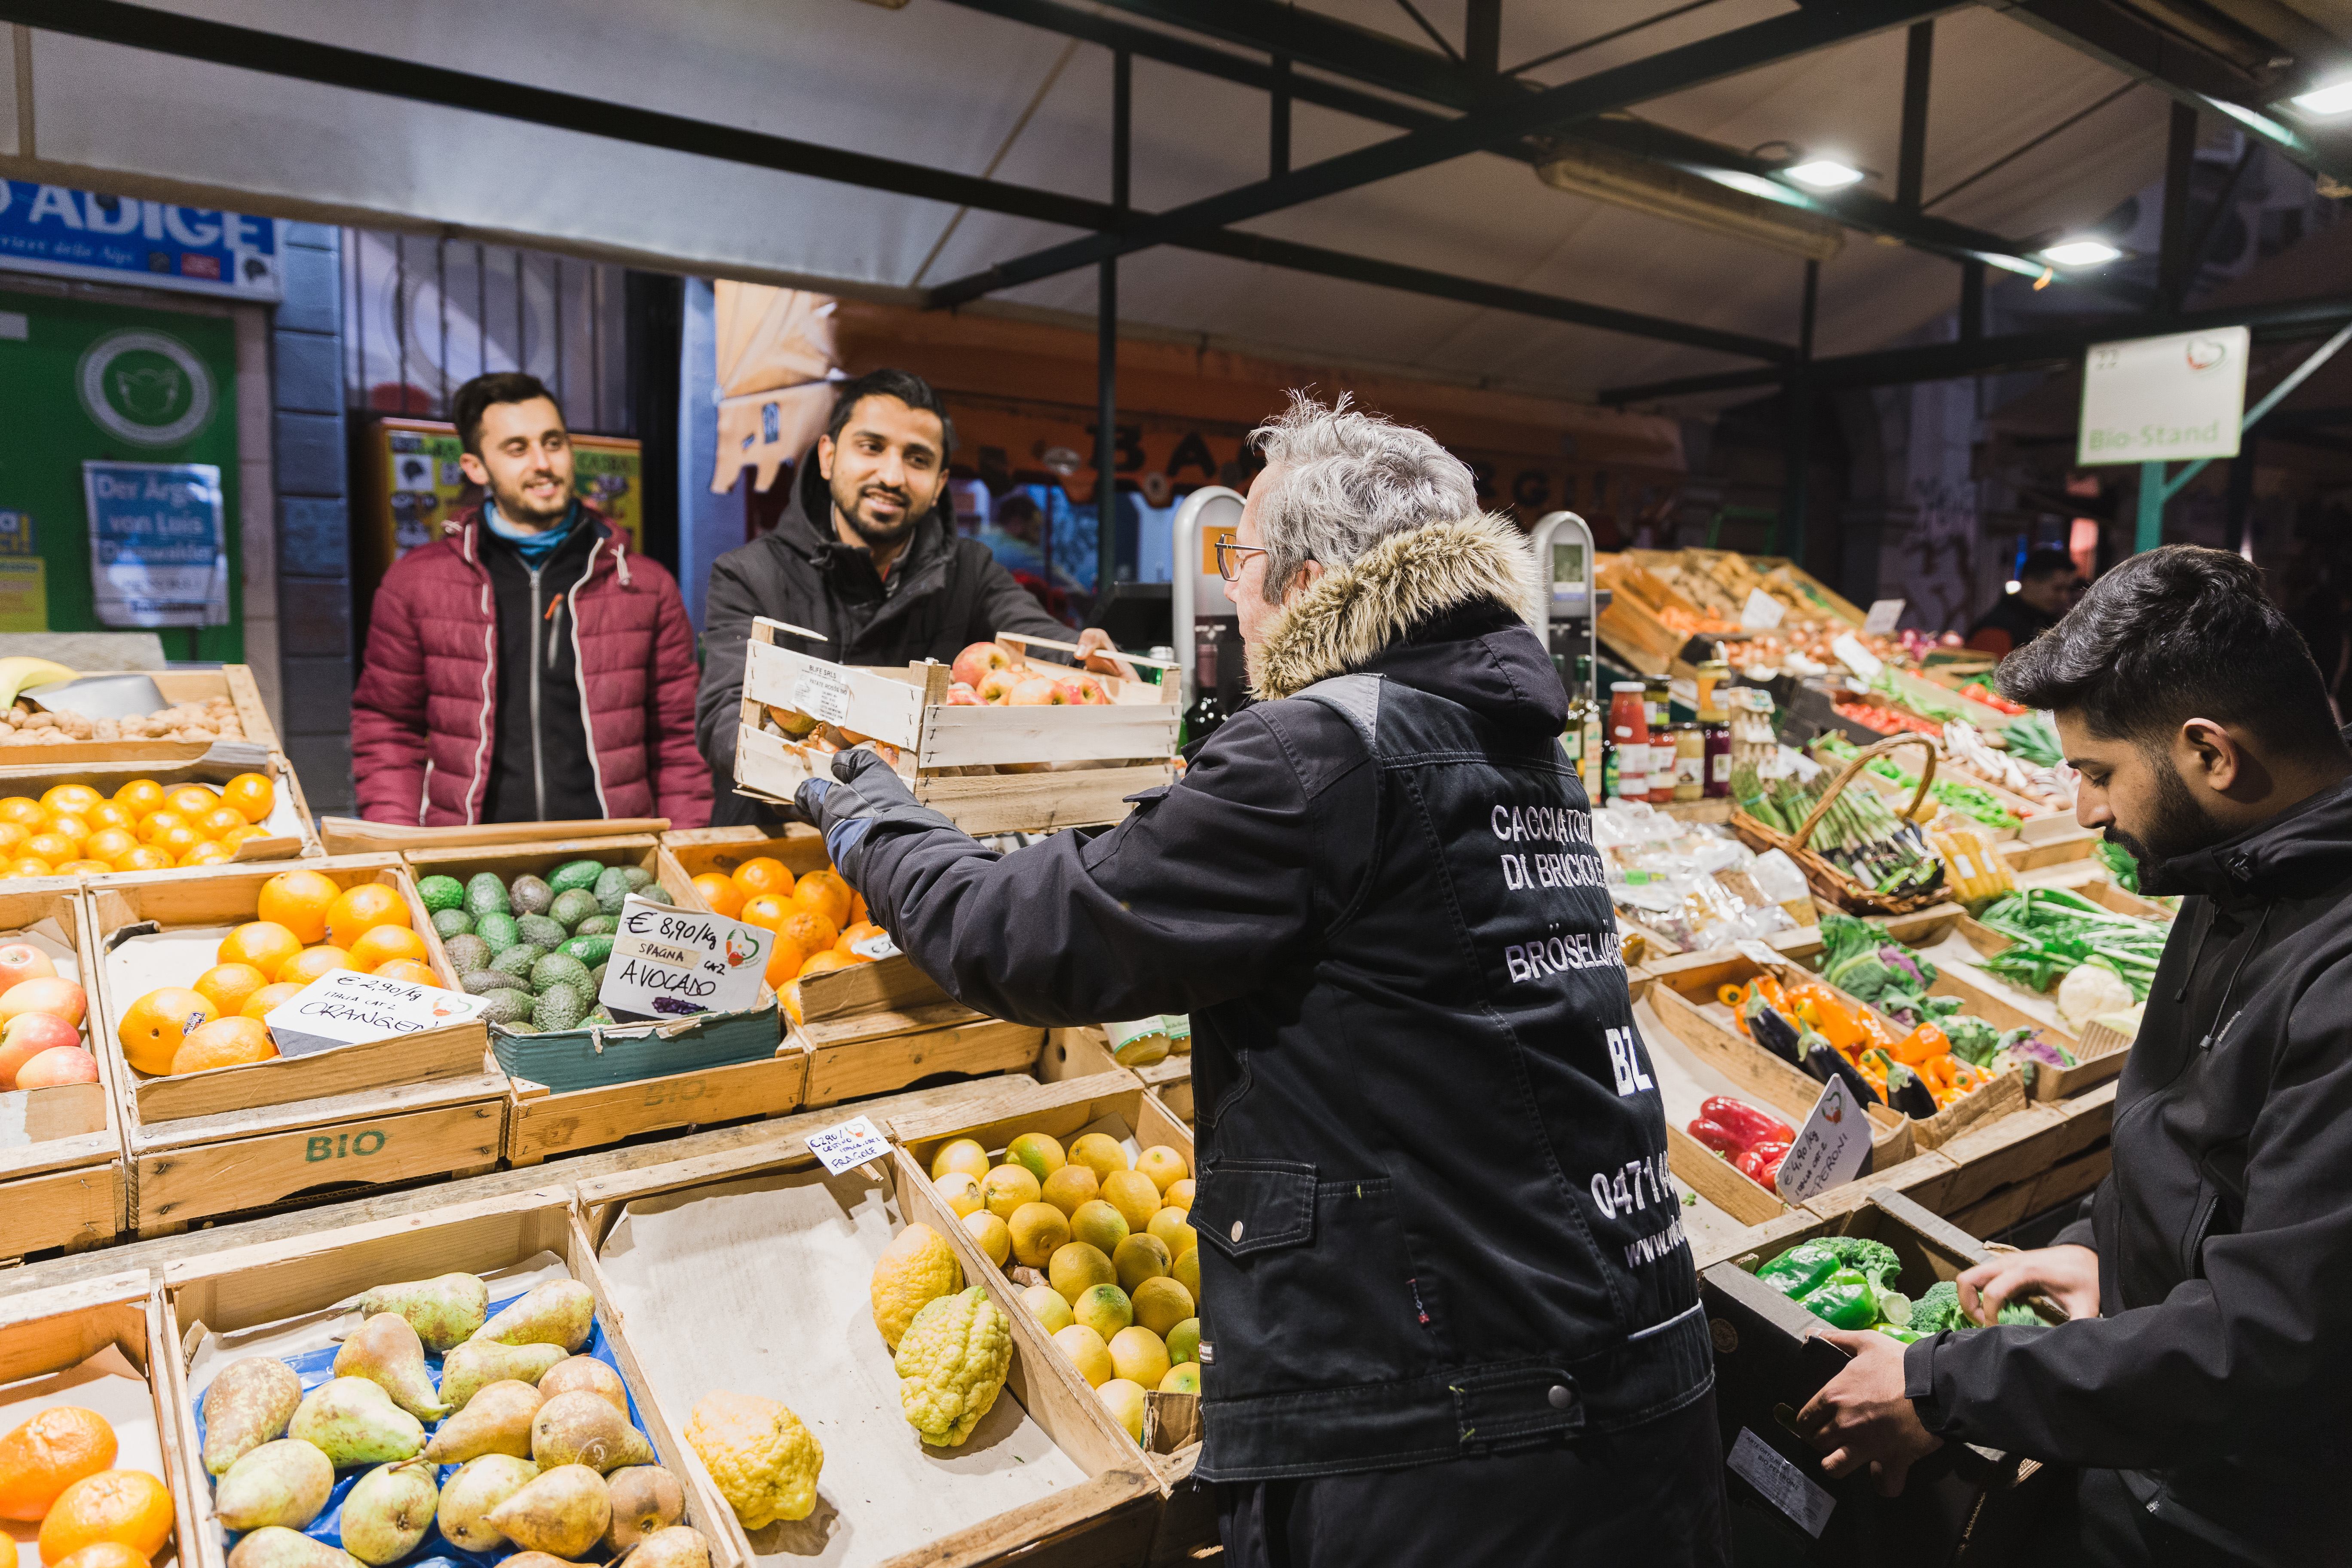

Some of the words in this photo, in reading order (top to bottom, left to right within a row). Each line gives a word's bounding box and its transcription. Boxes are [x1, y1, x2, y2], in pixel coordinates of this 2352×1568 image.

[28, 182, 260, 250] ADIGE
[1501, 854, 1534, 891] DI
[625, 912, 657, 933] €
[639, 943, 684, 962] SPAGNA
[337, 977, 361, 989] €
[620, 959, 715, 996] AVOCADO
[324, 991, 359, 1001] ITALIA
[305, 1130, 387, 1163] BIO
[831, 1147, 877, 1168] FRAGOLE
[1746, 1436, 1760, 1449] ARTE
[1759, 1446, 1774, 1460] ORTO
[1774, 1458, 1787, 1470] NEW
[1758, 1455, 1769, 1465] BIO
[1769, 1464, 1799, 1491] PEPERONE
